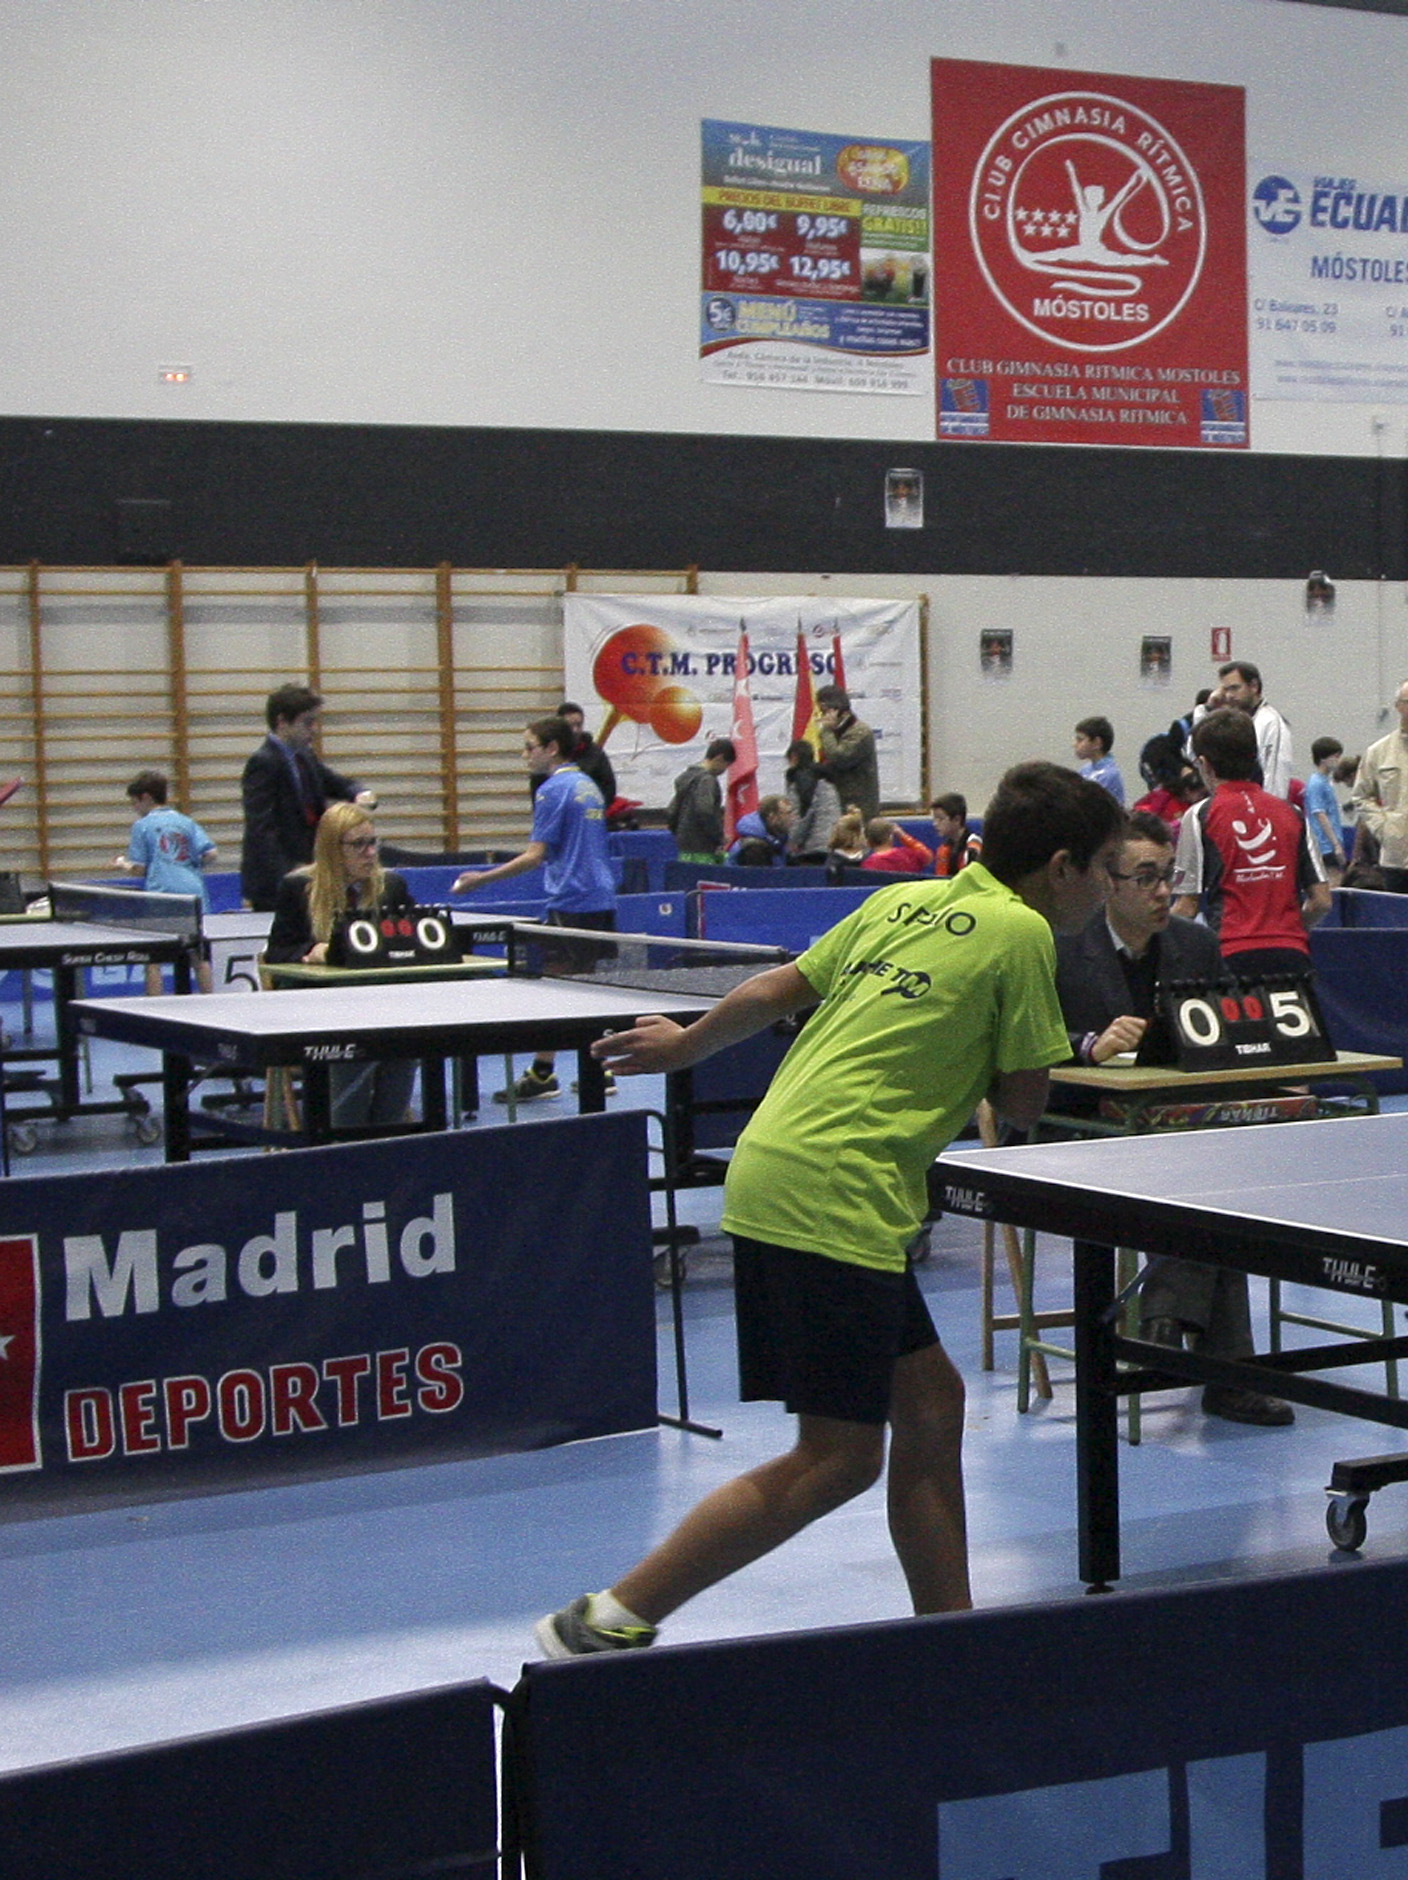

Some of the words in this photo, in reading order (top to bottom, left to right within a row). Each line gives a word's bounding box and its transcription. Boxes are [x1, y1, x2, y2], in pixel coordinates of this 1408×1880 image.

[729, 147, 821, 175] desigual
[984, 155, 1014, 220] CLUB
[1138, 131, 1194, 232] RÍTMICA
[1034, 295, 1150, 322] MÓSTOLES
[947, 358, 993, 374] CLUB
[997, 361, 1080, 379] GIMNASIA
[1012, 383, 1087, 401] ESCUELA
[1091, 386, 1180, 404] MUNICIPAL
[1007, 404, 1028, 419] DE
[1033, 406, 1116, 424] GIMNASIA
[621, 652, 698, 677] C.T.M.
[706, 652, 836, 677] PROGRSO
[350, 920, 378, 952] 0
[417, 917, 446, 949] 0
[225, 954, 259, 991] 5
[1180, 998, 1220, 1047] 0
[1270, 991, 1311, 1037] 5
[303, 1043, 356, 1061] THULE
[63, 1192, 456, 1322] Madrid
[1322, 1257, 1376, 1289] THULE
[63, 1342, 464, 1463] DEPORTES
